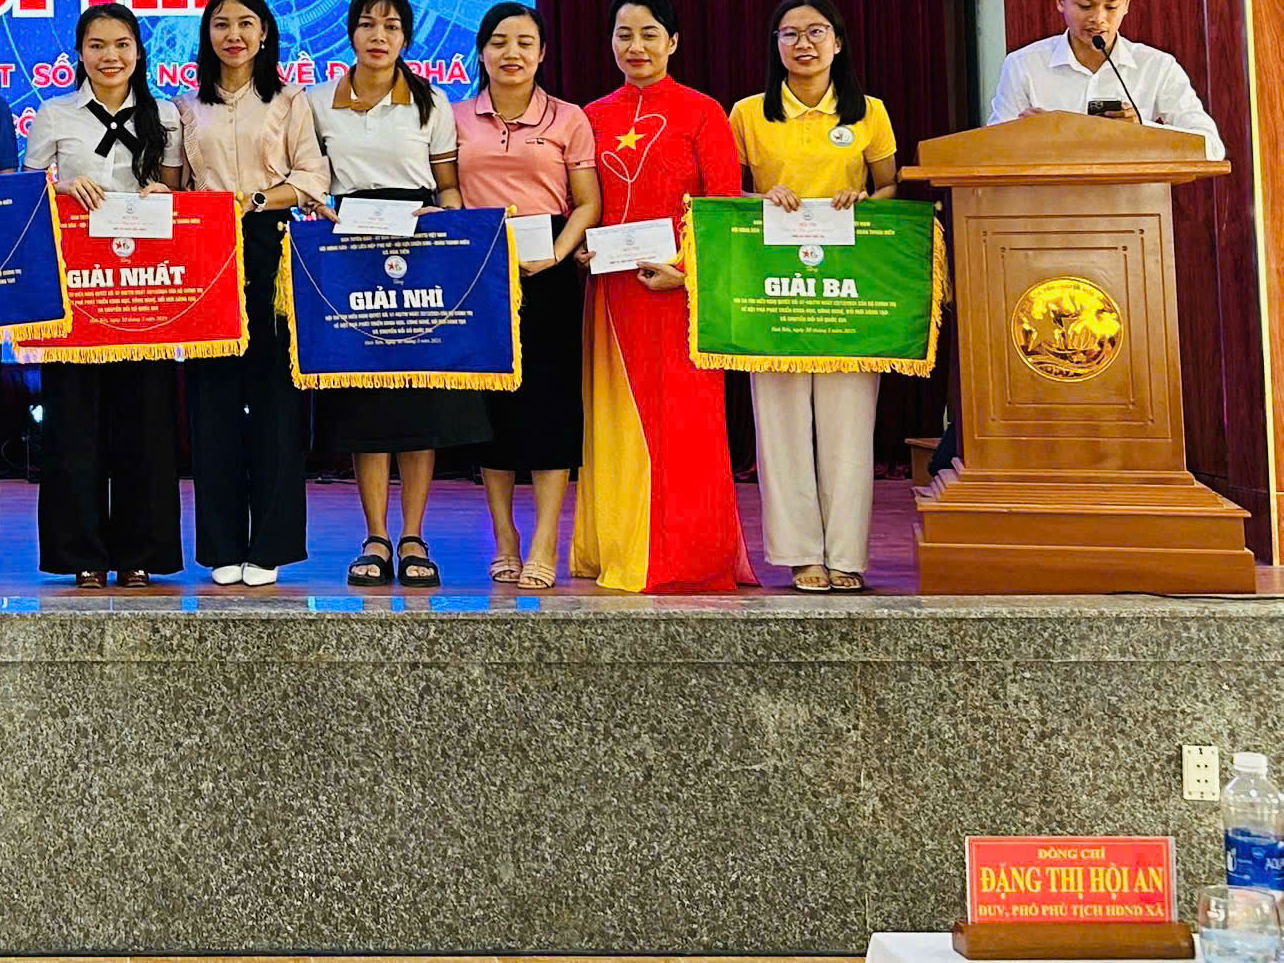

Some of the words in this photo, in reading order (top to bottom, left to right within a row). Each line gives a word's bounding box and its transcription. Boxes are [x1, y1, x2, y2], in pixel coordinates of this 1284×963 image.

[33, 52, 76, 87] SỐ
[67, 264, 115, 289] GIẢI
[120, 260, 186, 287] NHẤT
[764, 272, 816, 297] GIẢI
[822, 278, 859, 298] BA
[349, 286, 398, 311] GIẢI
[403, 285, 444, 309] NHÌ
[1080, 846, 1106, 859] CHÍ
[980, 862, 1042, 900] ĐẶNG
[1045, 866, 1083, 900] THỊ
[1089, 861, 1130, 900] HỘI
[1134, 866, 1164, 893] AN
